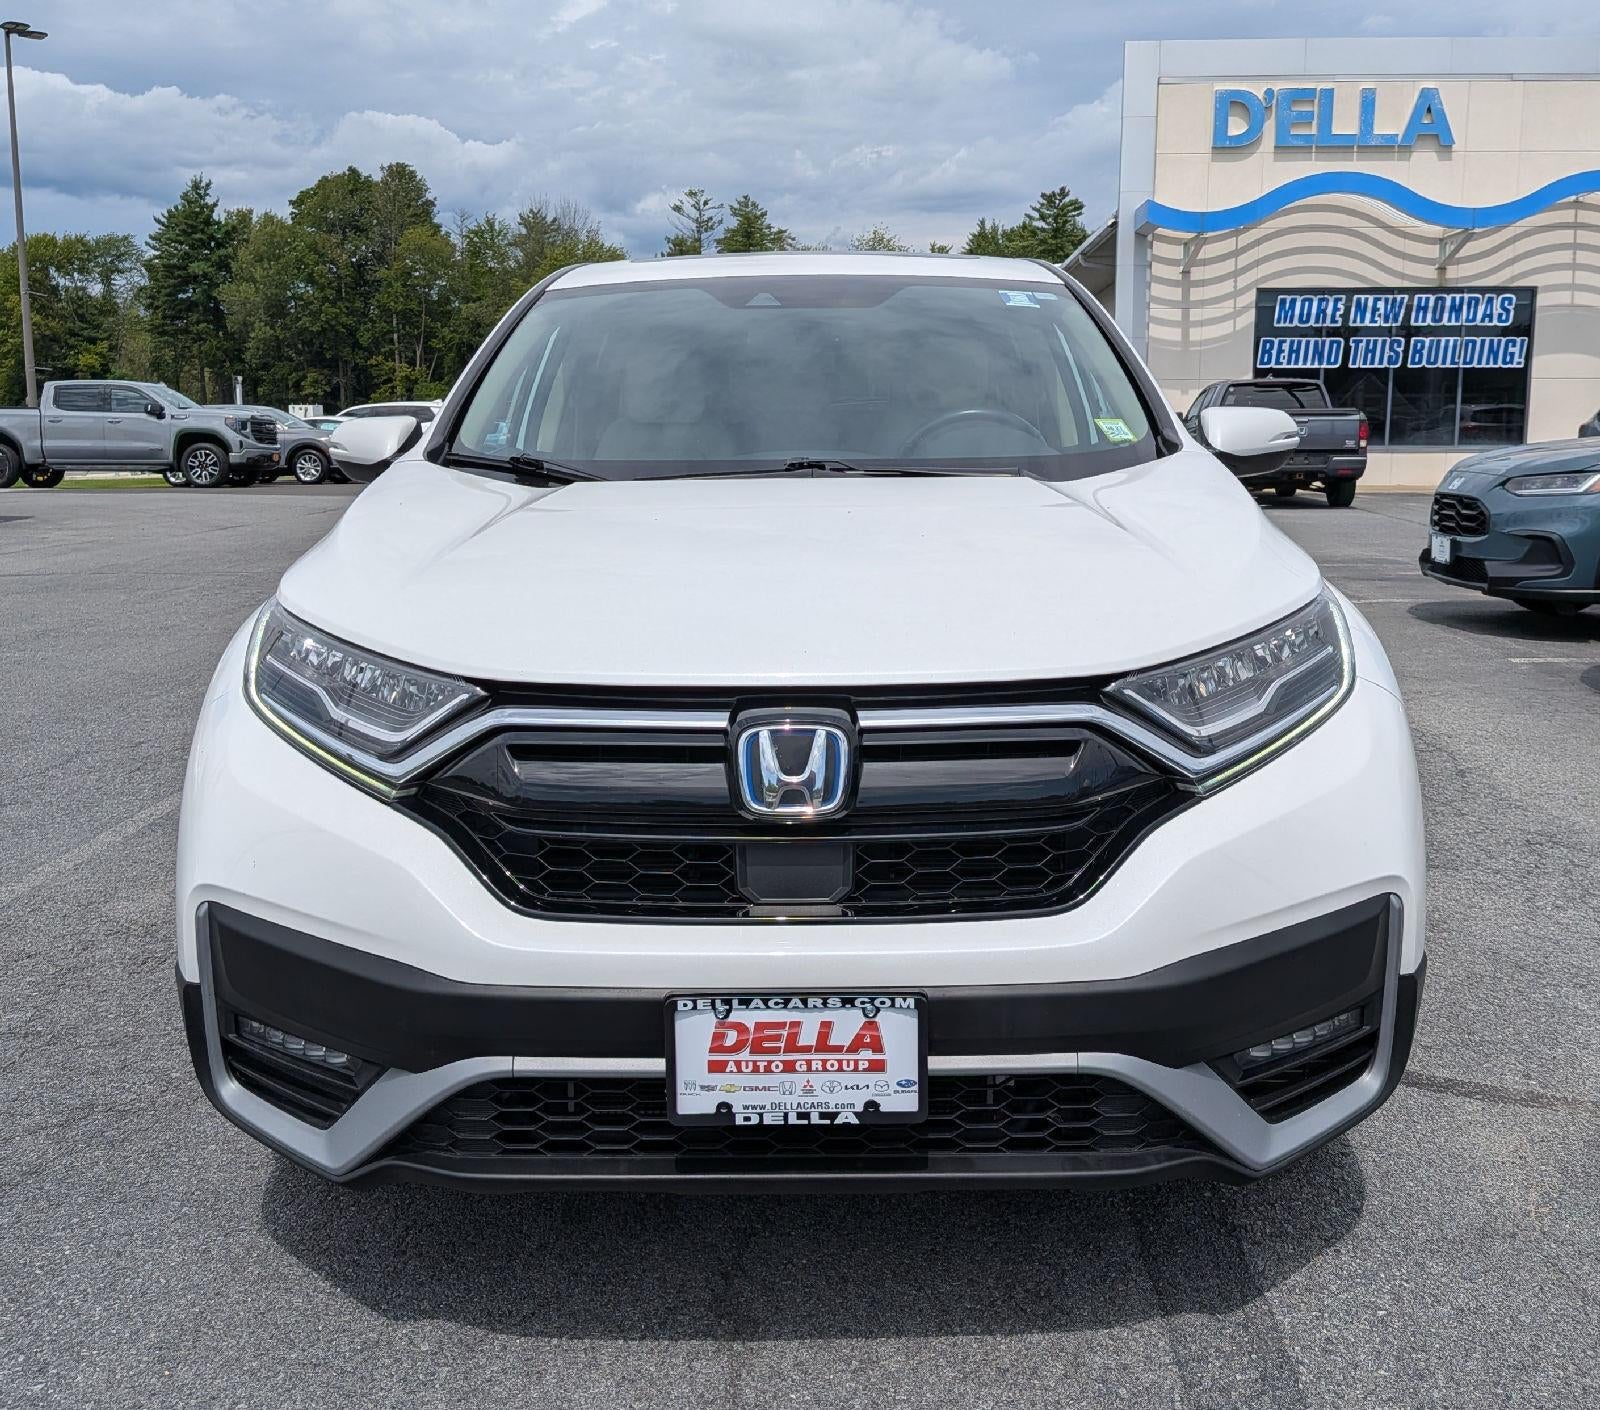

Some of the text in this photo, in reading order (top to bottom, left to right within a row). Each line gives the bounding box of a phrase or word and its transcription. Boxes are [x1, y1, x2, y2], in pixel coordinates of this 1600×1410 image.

[1212, 87, 1455, 148] D'ELLA
[1274, 294, 1516, 327] MORE NEW HONDAS
[1257, 337, 1527, 368] BEHIND THIS BUILDING!
[677, 998, 915, 1010] DELLACARS.COM
[708, 1020, 886, 1056] DELLA
[725, 1060, 870, 1072] AUTO GROUP
[742, 1101, 855, 1110] www.DELLACARS.com
[735, 1112, 860, 1124] DELLA
